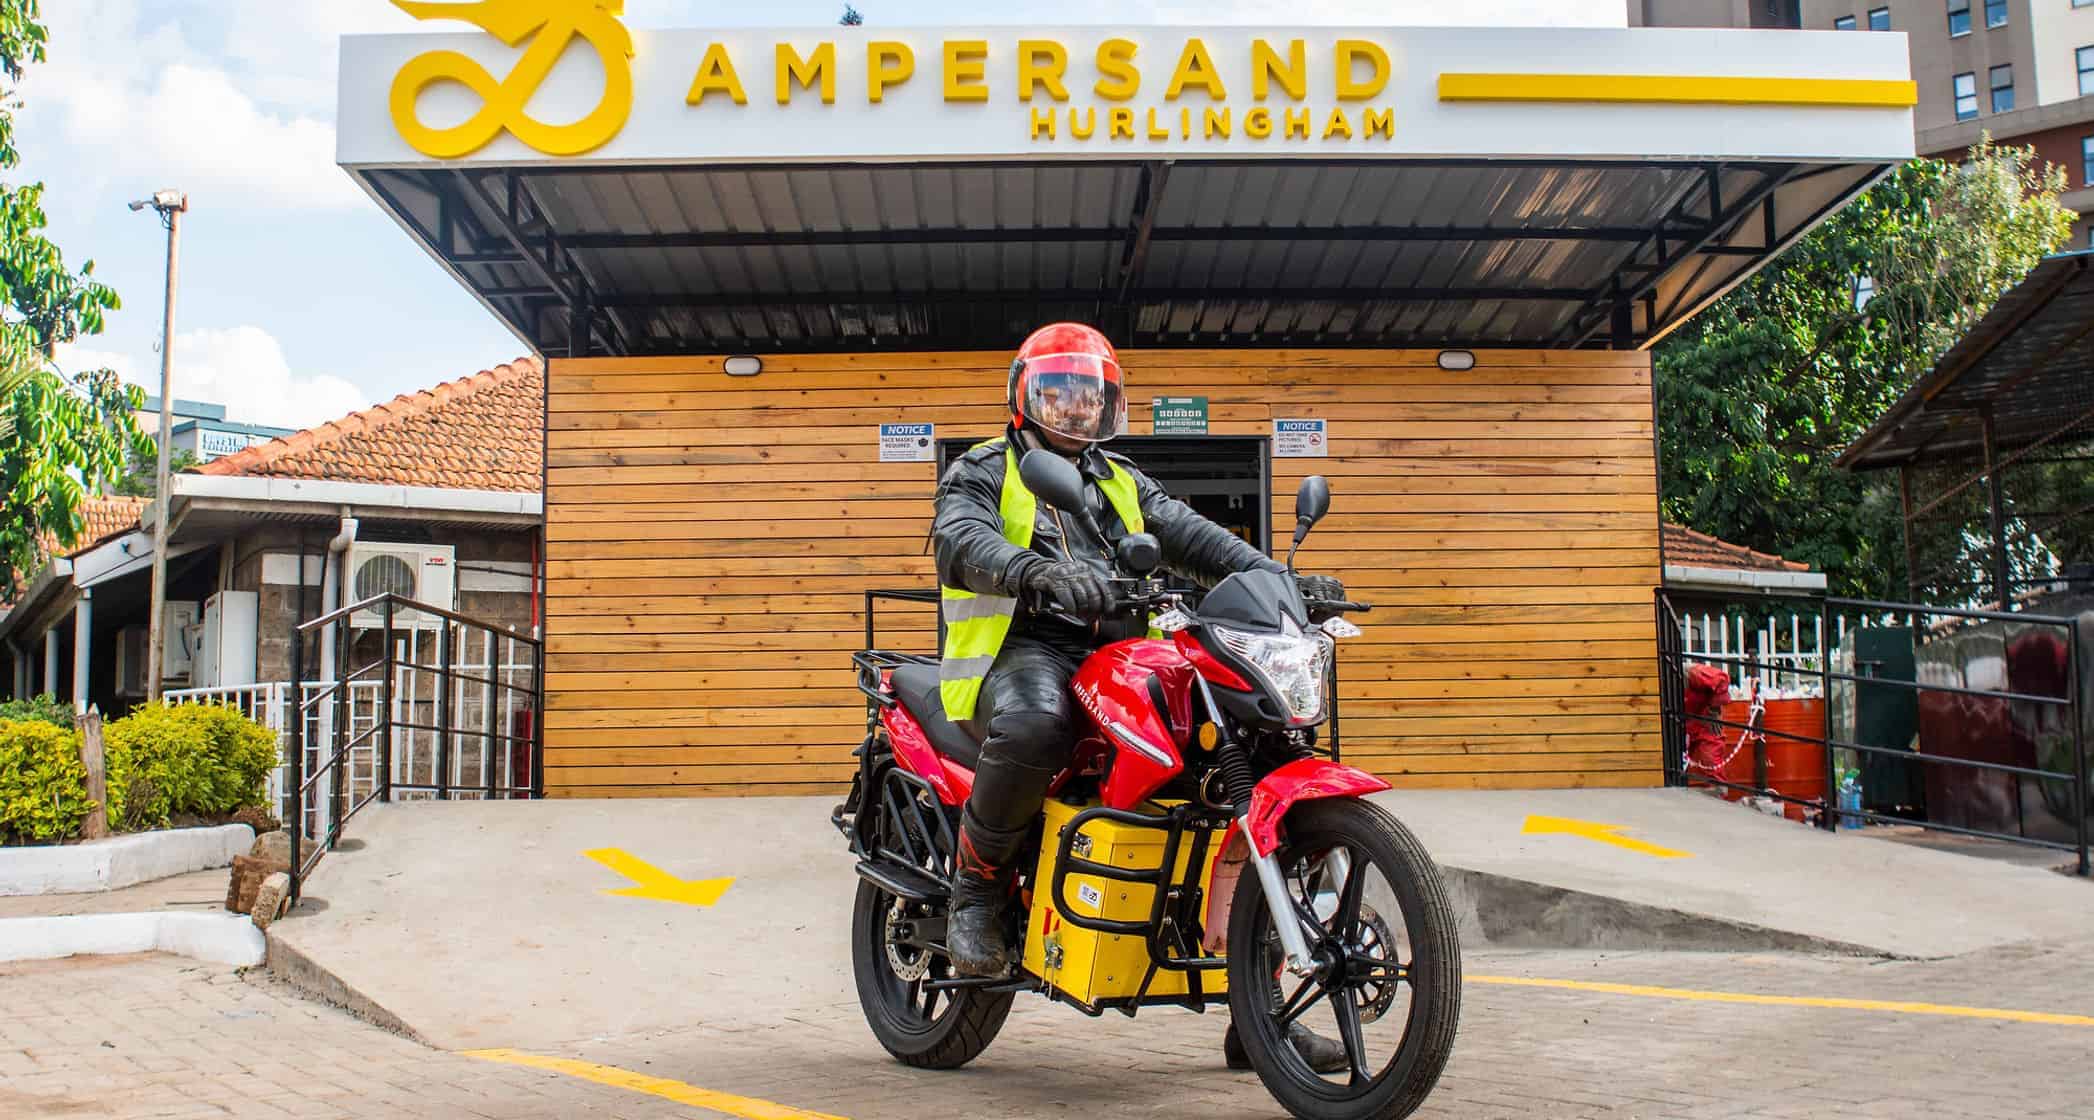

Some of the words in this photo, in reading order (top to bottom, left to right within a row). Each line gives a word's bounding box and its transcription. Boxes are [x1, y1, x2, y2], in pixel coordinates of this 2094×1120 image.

[685, 39, 1392, 105] AMPERSAND
[1031, 107, 1394, 140] HURLINGHAM
[887, 425, 926, 434] NOTICE
[1283, 422, 1317, 430] NOTICE
